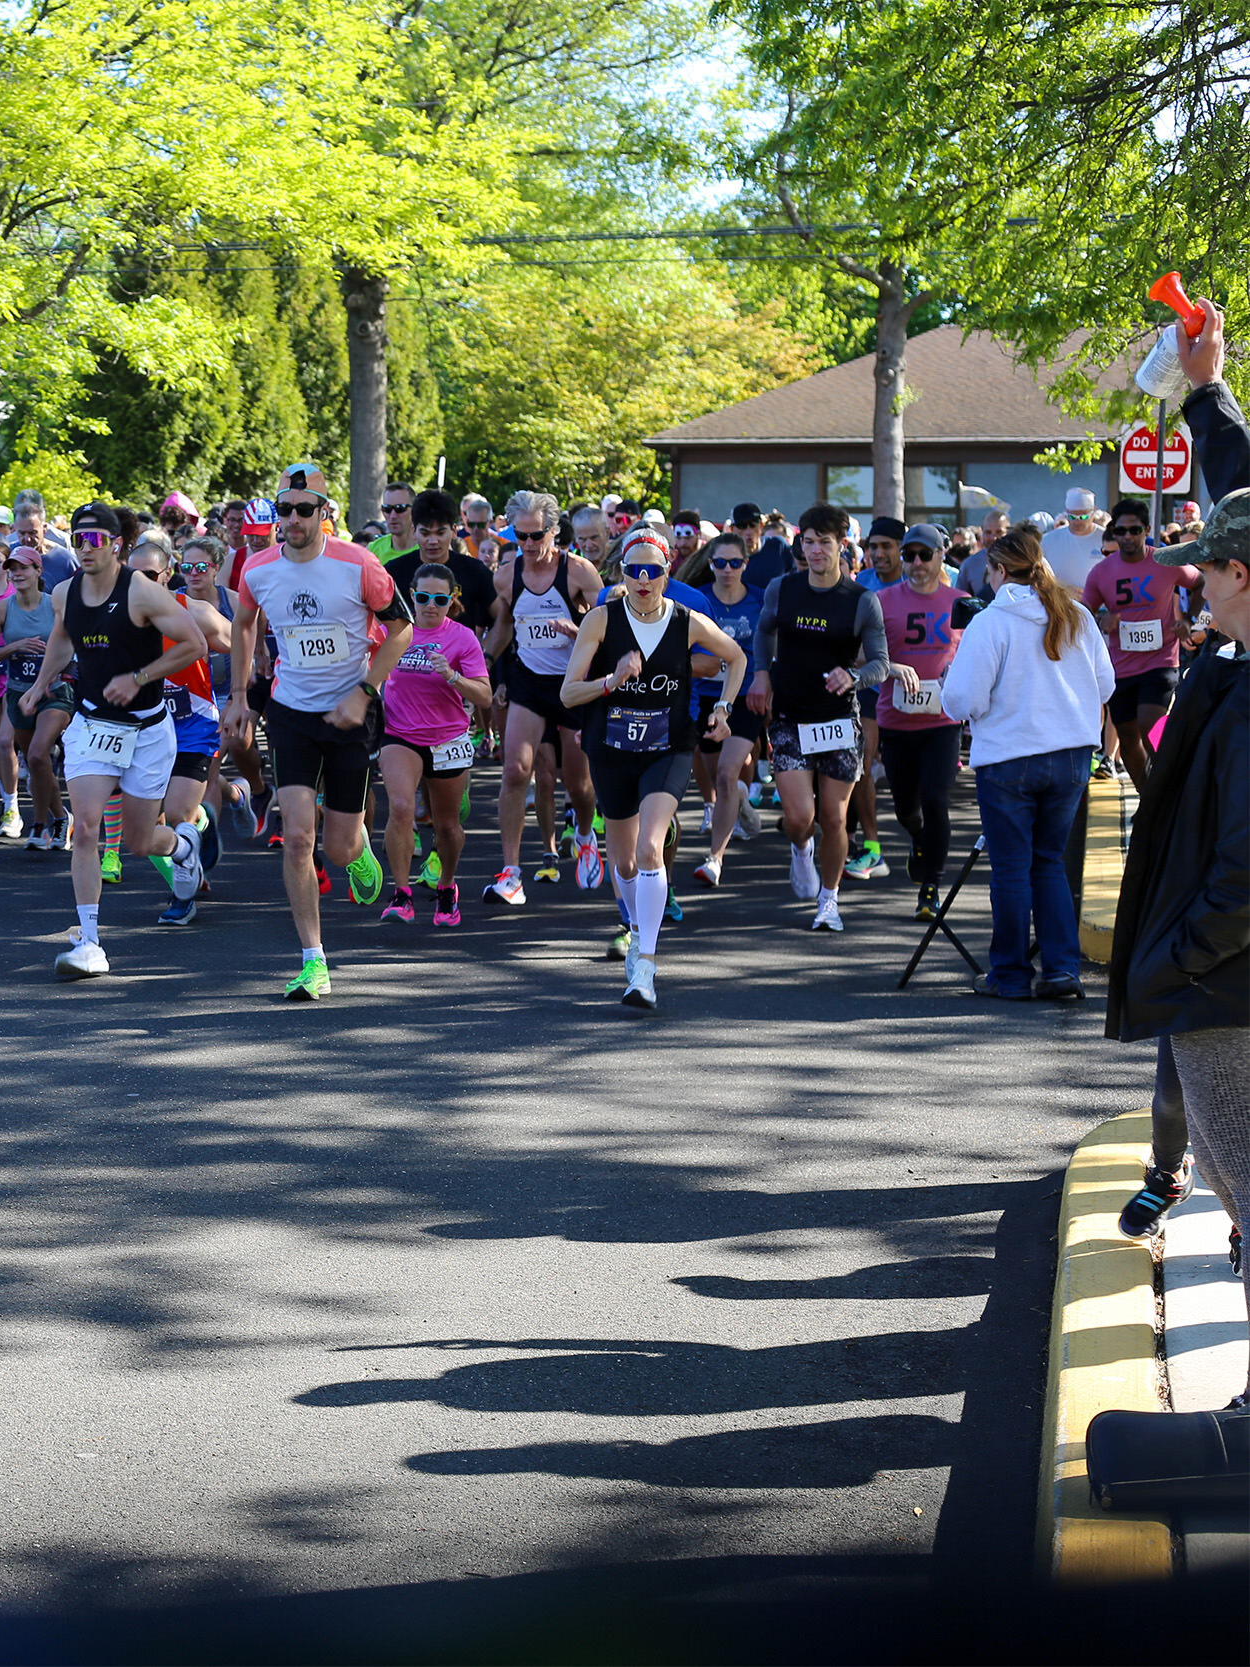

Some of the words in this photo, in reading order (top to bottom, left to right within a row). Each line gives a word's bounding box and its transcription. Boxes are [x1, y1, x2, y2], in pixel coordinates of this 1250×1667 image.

[1133, 436, 1150, 448] DO
[1135, 466, 1174, 479] ENTER
[1116, 575, 1155, 605] 5K
[796, 616, 827, 627] HYPR
[796, 623, 825, 632] TRAINING
[904, 612, 951, 645] 5K
[82, 635, 110, 645] HYPR
[1129, 631, 1154, 643] 1395
[299, 638, 336, 657] 1293
[22, 662, 36, 676] 32
[651, 674, 679, 696] Ops
[627, 722, 648, 741] 57
[812, 724, 843, 742] 1178
[89, 733, 123, 753] 1175
[445, 742, 473, 760] 1319
